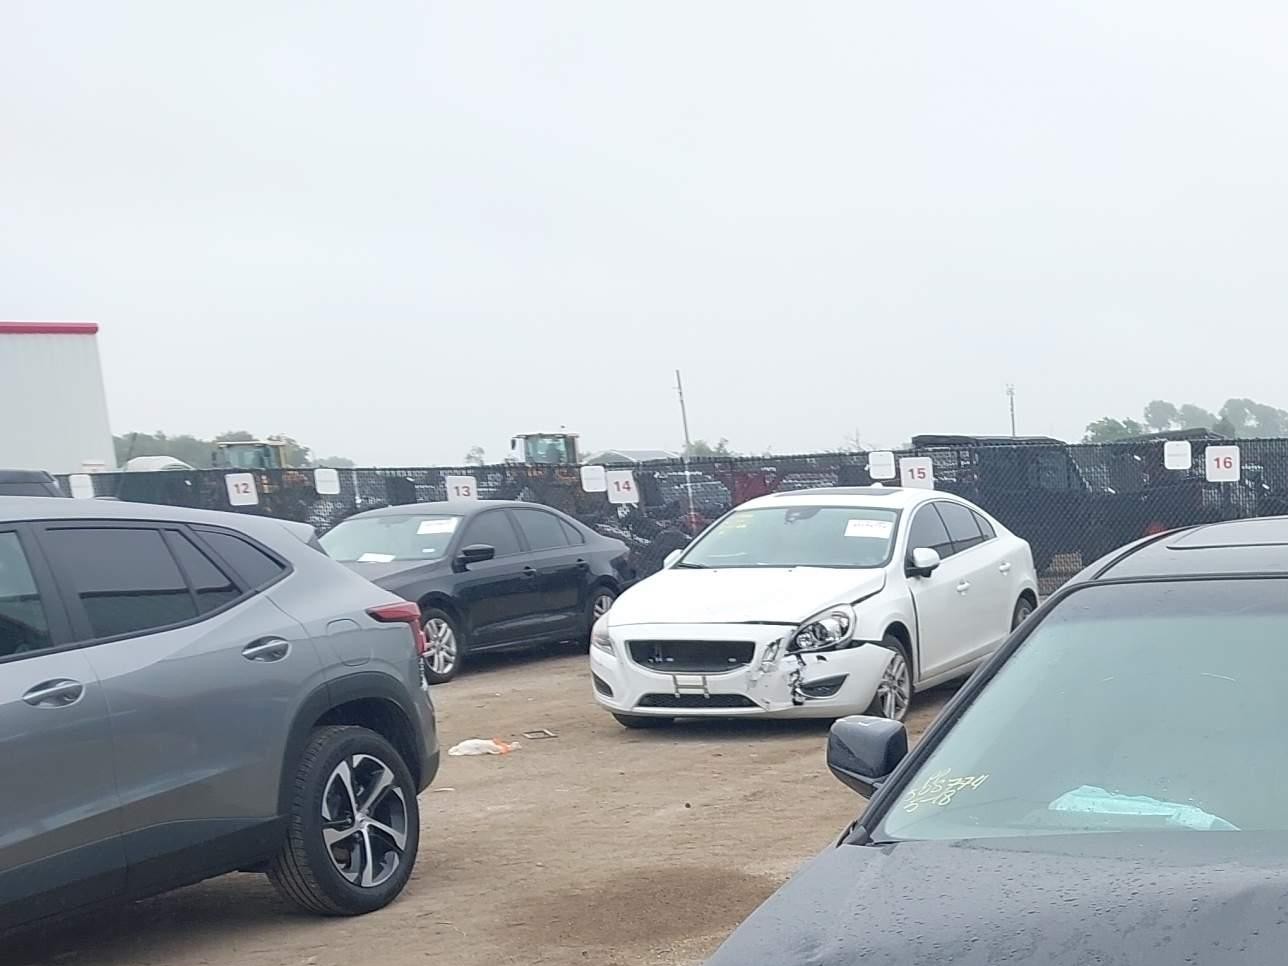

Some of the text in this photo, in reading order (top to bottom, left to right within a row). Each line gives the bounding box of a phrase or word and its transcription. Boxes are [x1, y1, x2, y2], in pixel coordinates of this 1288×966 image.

[1213, 456, 1233, 469] 16
[908, 467, 926, 480] 15
[234, 482, 252, 494] 12
[455, 485, 471, 497] 13
[613, 480, 632, 492] 14
